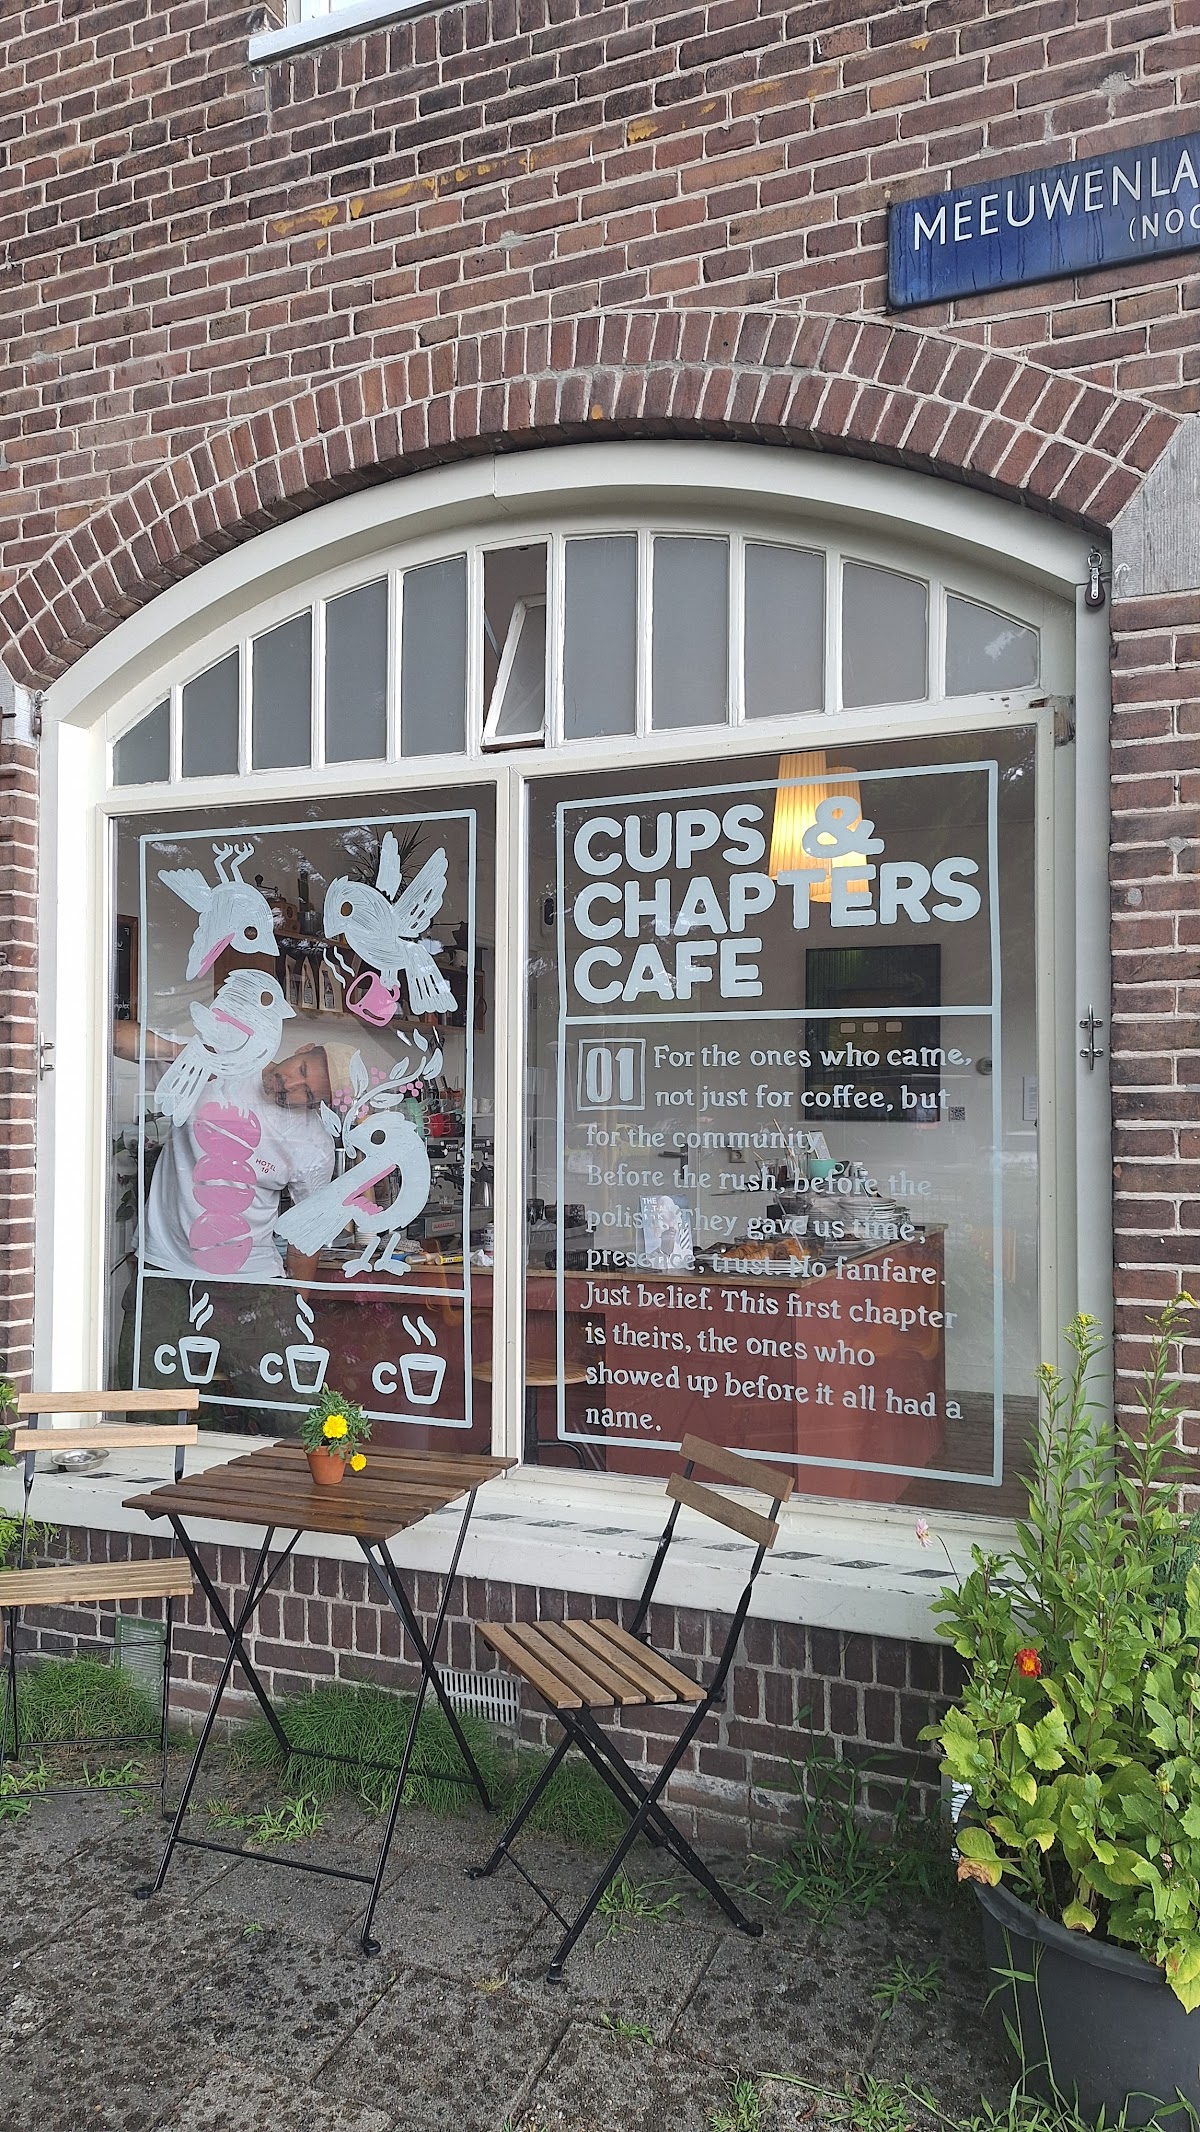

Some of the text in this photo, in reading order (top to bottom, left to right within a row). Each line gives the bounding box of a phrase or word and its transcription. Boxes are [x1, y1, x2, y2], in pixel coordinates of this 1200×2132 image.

[573, 795, 885, 876] CUPS &
[573, 856, 981, 941] CHAPTERS
[573, 937, 763, 1004] CAFE
[653, 1042, 972, 1069] For the ones who came,
[586, 1047, 634, 1103] 01
[655, 1084, 951, 1112] not just for coffee, but
[586, 1125, 621, 1147] for
[628, 1125, 666, 1149] the
[586, 1163, 932, 1197] Before the rush, before the
[642, 1197, 658, 1205] THE
[747, 1216, 808, 1241] gave
[813, 1220, 845, 1239] us
[852, 1217, 926, 1245] time,
[789, 1254, 827, 1278] No
[835, 1255, 948, 1287] fanfare.
[580, 1281, 958, 1332] Just belief. This first chapter
[585, 1321, 876, 1367] is theirs, the ones who
[585, 1360, 964, 1420] showed up before it all had a
[585, 1407, 662, 1432] name.
